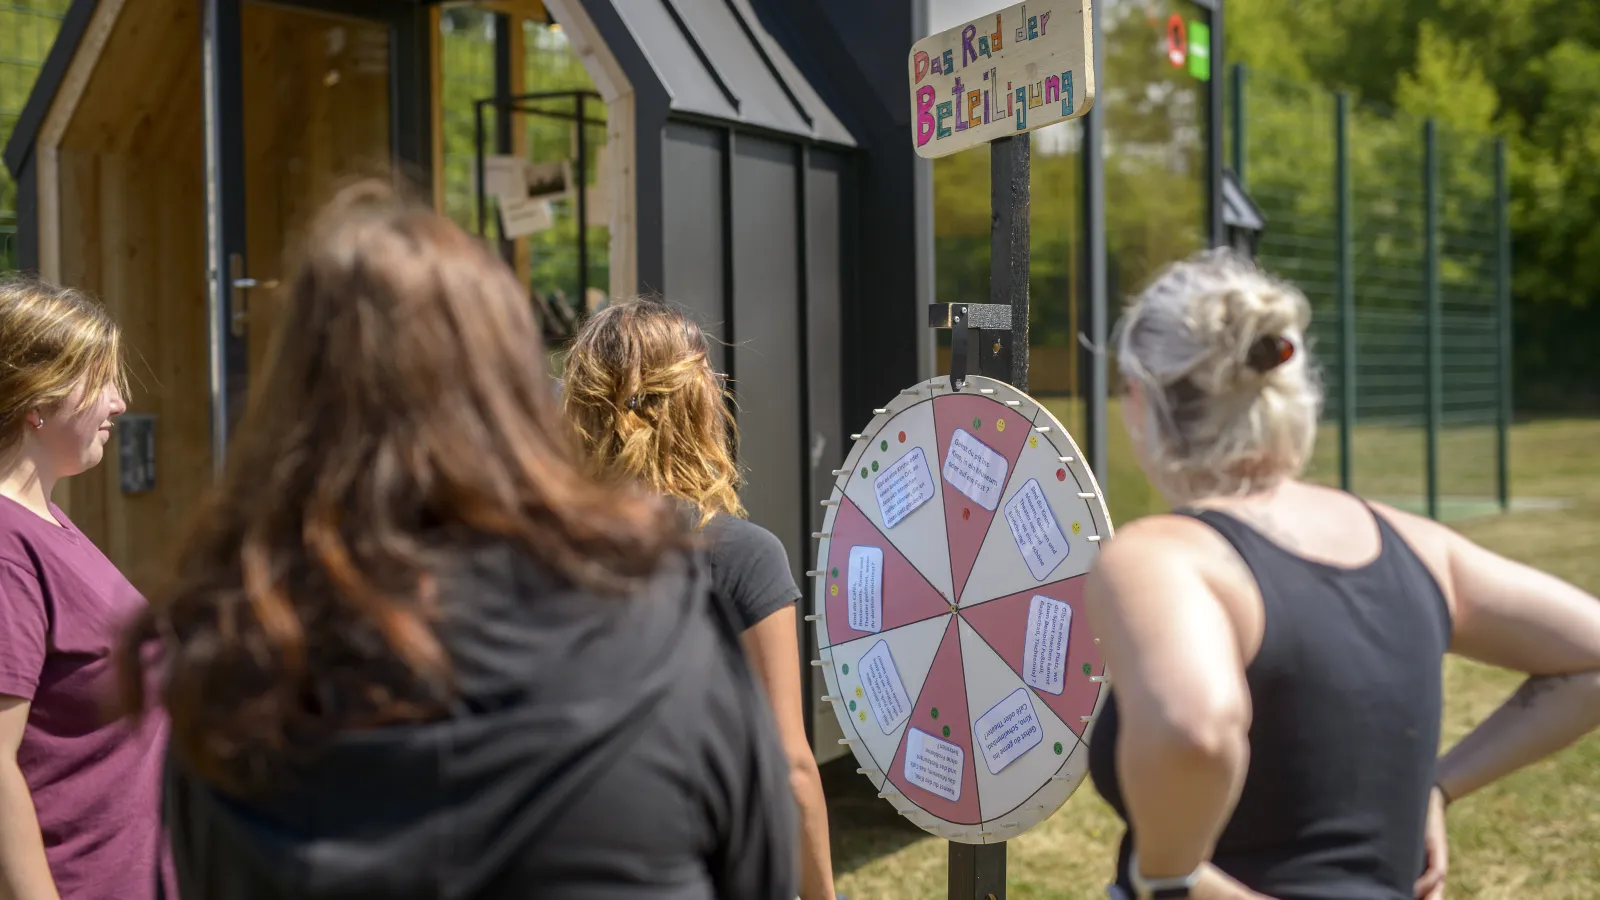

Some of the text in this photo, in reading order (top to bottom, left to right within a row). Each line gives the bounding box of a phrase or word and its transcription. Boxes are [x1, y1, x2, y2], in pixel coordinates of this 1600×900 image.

[914, 5, 1052, 84] Das Rad der
[1020, 498, 1031, 521] Theater
[1035, 534, 1043, 545] und
[1049, 543, 1057, 555] und
[1004, 712, 1015, 723] oder
[1021, 726, 1036, 739] Gehst
[1000, 740, 1013, 754] gerne
